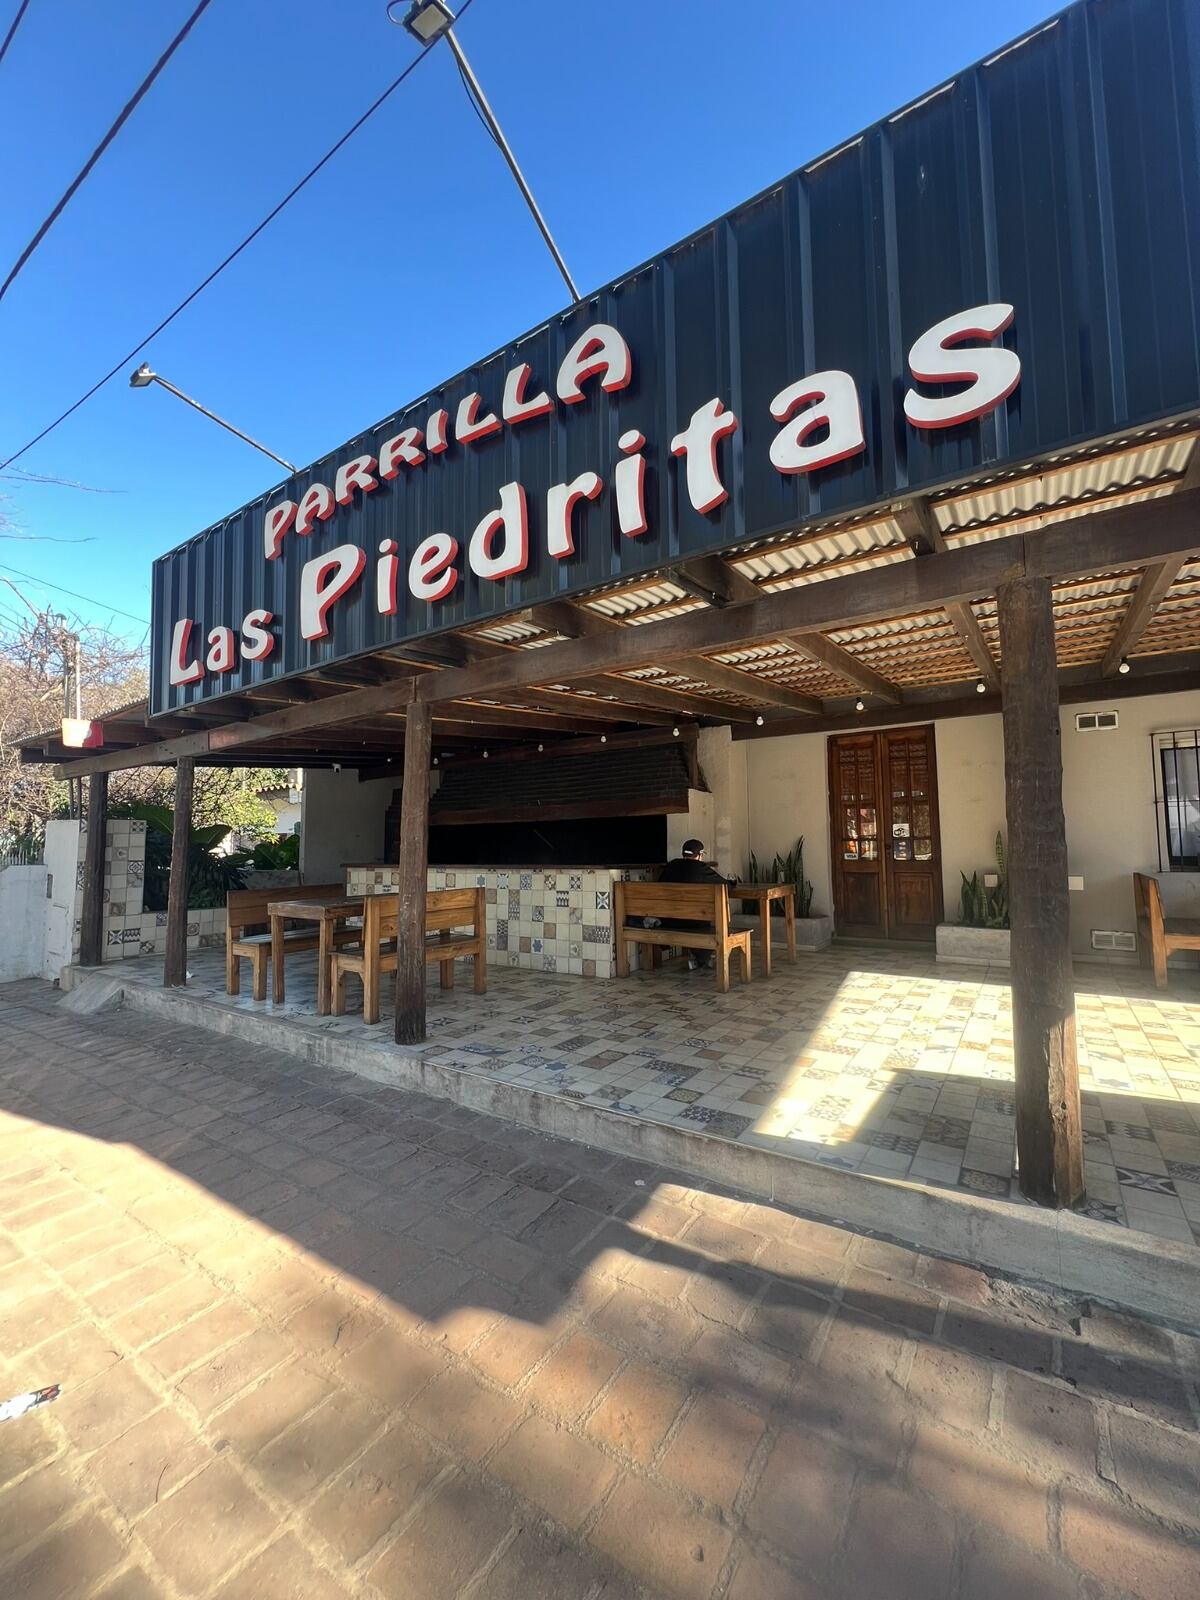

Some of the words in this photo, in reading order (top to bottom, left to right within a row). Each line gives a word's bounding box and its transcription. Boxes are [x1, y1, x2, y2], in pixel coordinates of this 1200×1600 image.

[169, 608, 274, 687] Las
[300, 303, 1021, 642] Piedritas
[264, 323, 632, 561] PARRILLA
